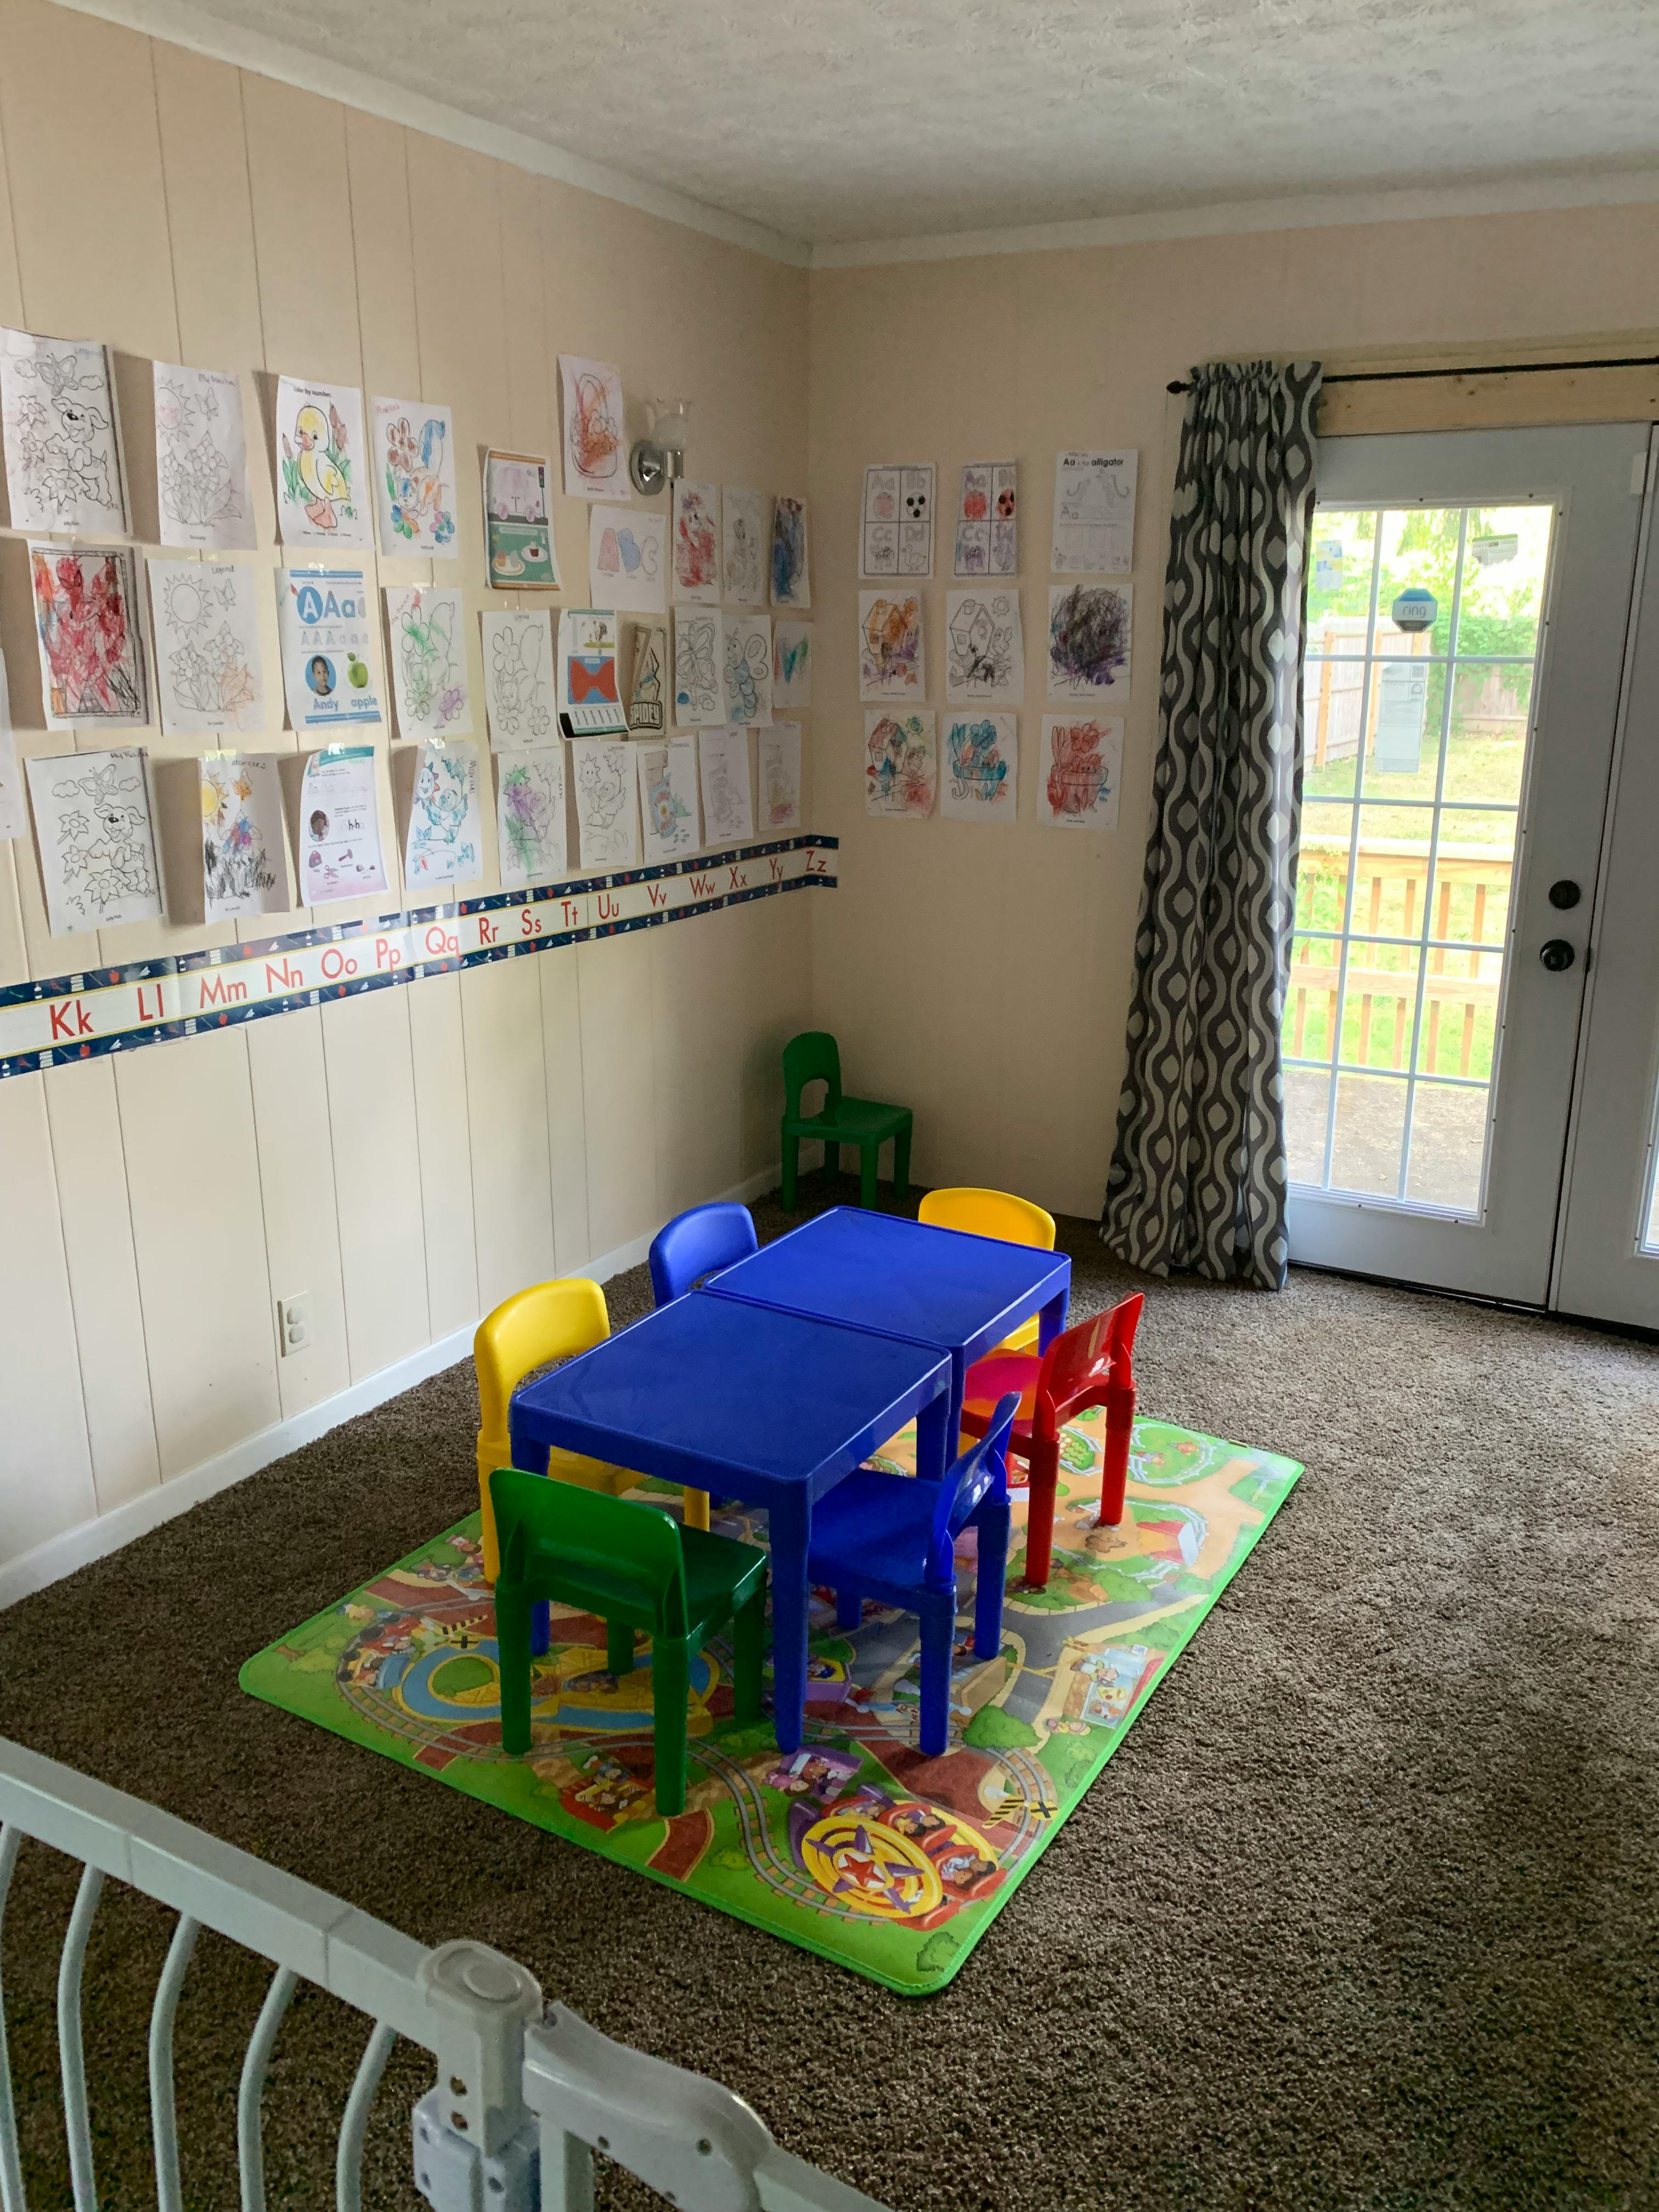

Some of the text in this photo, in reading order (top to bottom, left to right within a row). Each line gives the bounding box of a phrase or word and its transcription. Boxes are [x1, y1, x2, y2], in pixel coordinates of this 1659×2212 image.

[1063, 458, 1075, 466] Aa
[1091, 457, 1124, 467] alligator
[1402, 603, 1426, 618] ring
[313, 695, 378, 712] Andy apple
[49, 1000, 94, 1041] Kk
[200, 974, 247, 1009] Mm
[266, 958, 303, 993] Nn
[321, 949, 358, 979] Oo
[376, 938, 401, 972] Pp
[425, 926, 460, 957] Qq
[479, 916, 499, 945] Rr
[521, 909, 542, 936] Ss
[561, 900, 578, 927] Tt
[598, 894, 619, 920] Uu
[647, 884, 667, 907] Vv
[689, 874, 715, 898] Ww
[730, 866, 747, 889] Xx
[769, 857, 783, 884] Yy
[806, 850, 826, 873] Zz
